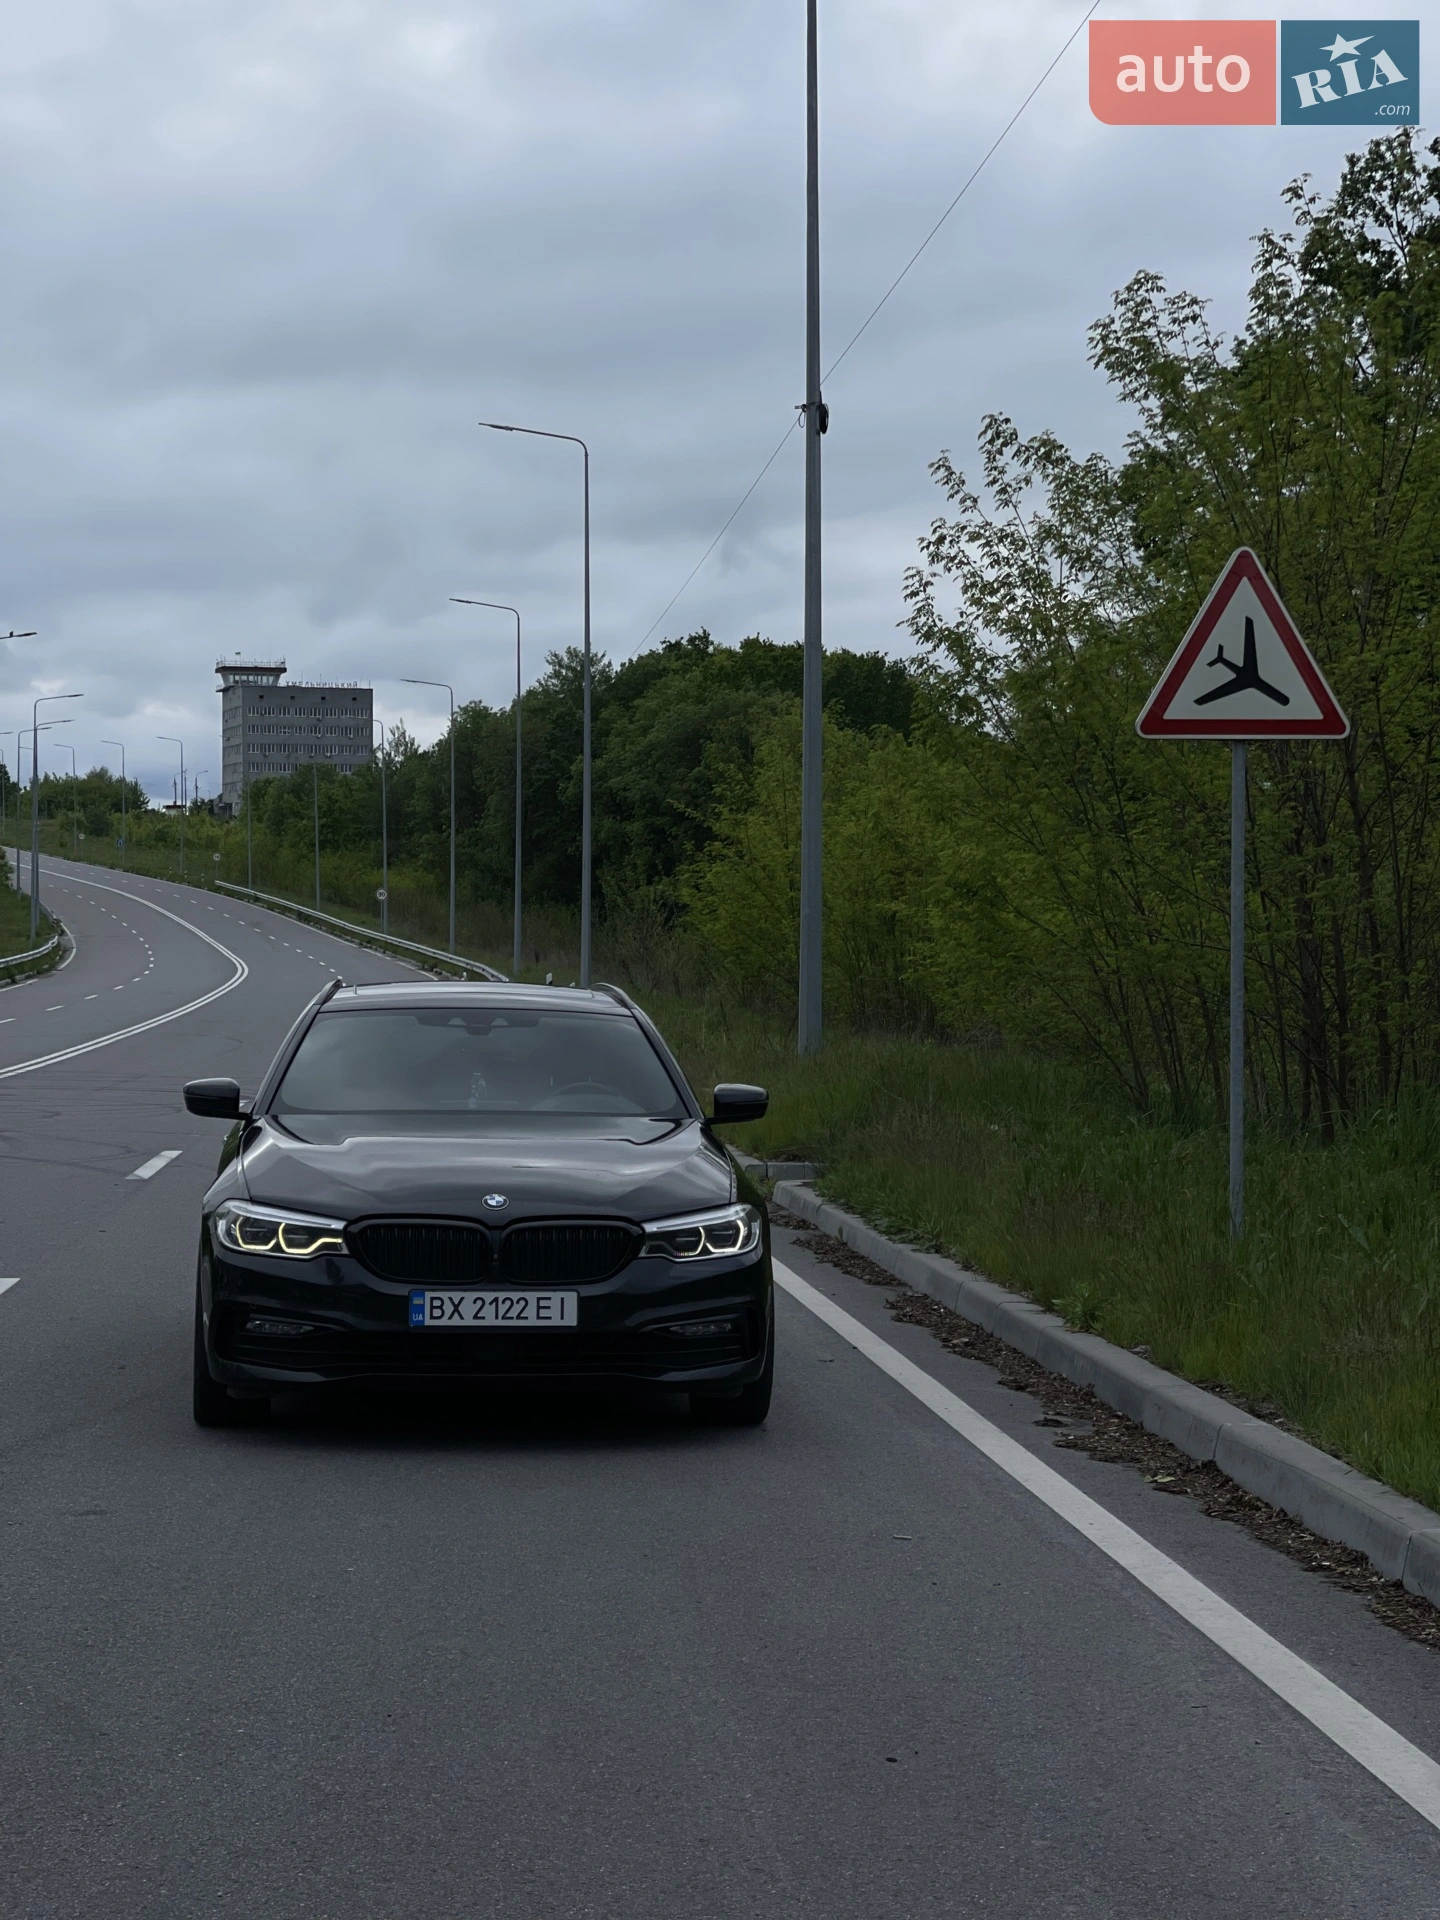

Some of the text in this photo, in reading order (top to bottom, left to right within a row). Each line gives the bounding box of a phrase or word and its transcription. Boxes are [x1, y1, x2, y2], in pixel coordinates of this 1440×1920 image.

[429, 1296, 565, 1320] BX 2122 EI
[412, 1313, 424, 1321] UA
